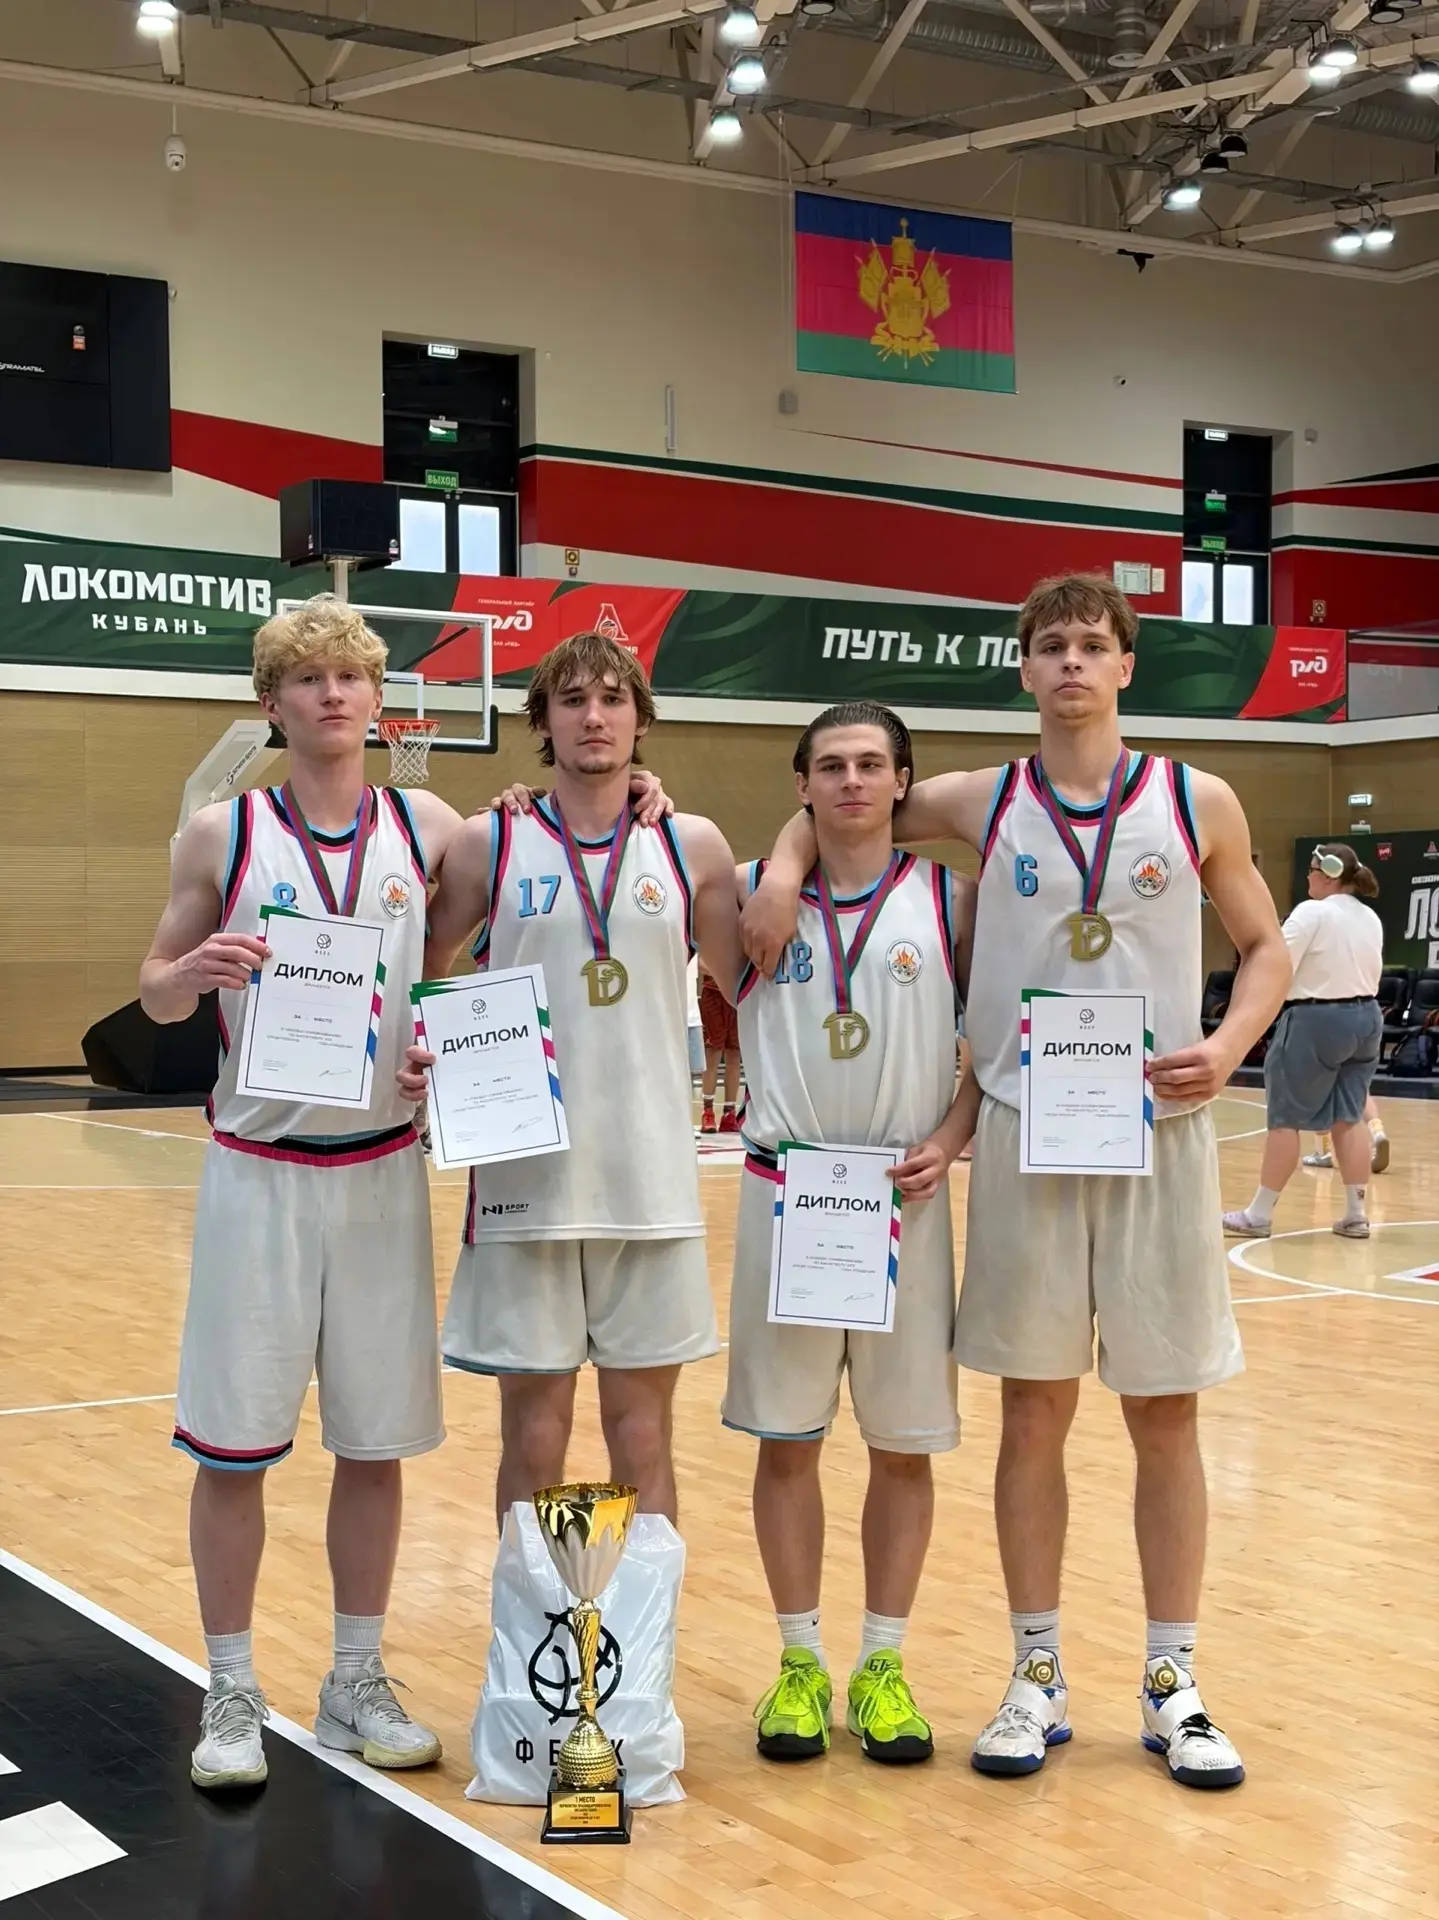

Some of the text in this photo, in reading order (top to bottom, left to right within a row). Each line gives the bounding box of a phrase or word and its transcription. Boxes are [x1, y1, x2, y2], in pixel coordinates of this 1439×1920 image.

[427, 474, 457, 488] ВЫХОД
[21, 563, 272, 617] ЛОКОМОТИВ
[92, 613, 207, 635] КУБАНЬ
[822, 627, 923, 663] ПУТЬ
[935, 633, 965, 666] К
[1015, 854, 1039, 896] 6
[518, 875, 561, 917] 17
[274, 963, 364, 987] ДИПЛОМ
[442, 1024, 529, 1056] ДИПЛОМ
[1042, 1042, 1132, 1057] ДИПЛОМ
[505, 1203, 530, 1211] SPORT
[795, 1194, 881, 1213] ДИПЛОМ
